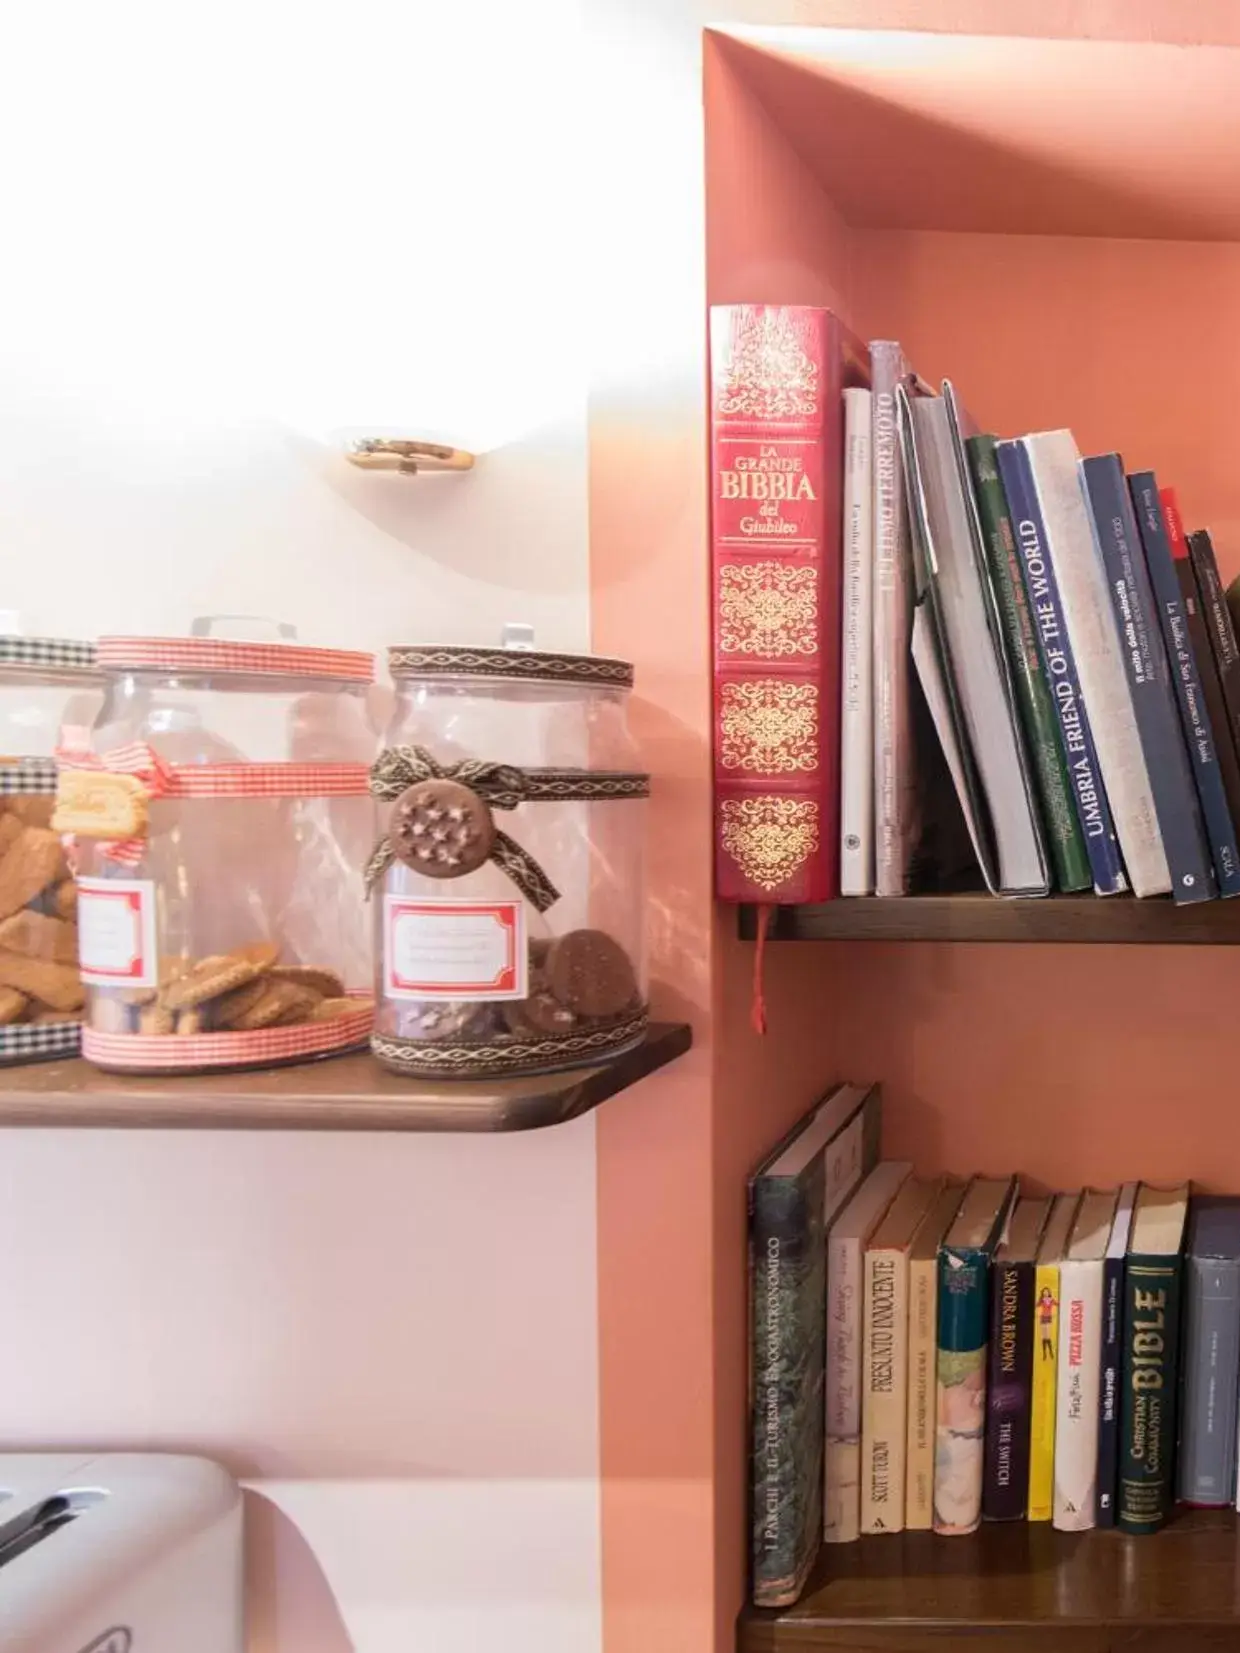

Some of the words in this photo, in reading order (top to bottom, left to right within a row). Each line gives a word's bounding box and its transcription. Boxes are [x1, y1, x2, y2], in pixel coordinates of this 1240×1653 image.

[735, 457, 802, 471] GRANDE
[760, 446, 777, 457] LA
[874, 392, 894, 500] TERREMOTO
[720, 470, 816, 500] BIBBIA
[759, 500, 778, 516] del
[740, 517, 797, 535] Giubileo
[1017, 519, 1049, 597] WORLD
[1035, 601, 1060, 641] THE
[1165, 600, 1179, 614] La
[1046, 646, 1067, 675] OF
[1054, 680, 1084, 753] FRIEND
[1073, 757, 1104, 838] UMBRIA
[766, 1236, 782, 1380] ENOGASTRONOMICO
[869, 1260, 896, 1329] INNOCENTE
[1002, 1270, 1018, 1321] SANDRA
[868, 1331, 895, 1392] PRESUNTO
[1000, 1323, 1016, 1371] BROWN
[1132, 1287, 1167, 1392] BIBLE
[763, 1387, 779, 1447] TURISMO
[998, 1422, 1011, 1443] THE
[1131, 1395, 1146, 1459] CHRISTIAN
[1144, 1395, 1161, 1474] COMMUNITY
[870, 1473, 888, 1503] SCOTT
[995, 1445, 1011, 1486] SWITCH
[764, 1487, 779, 1538] PARCHI
